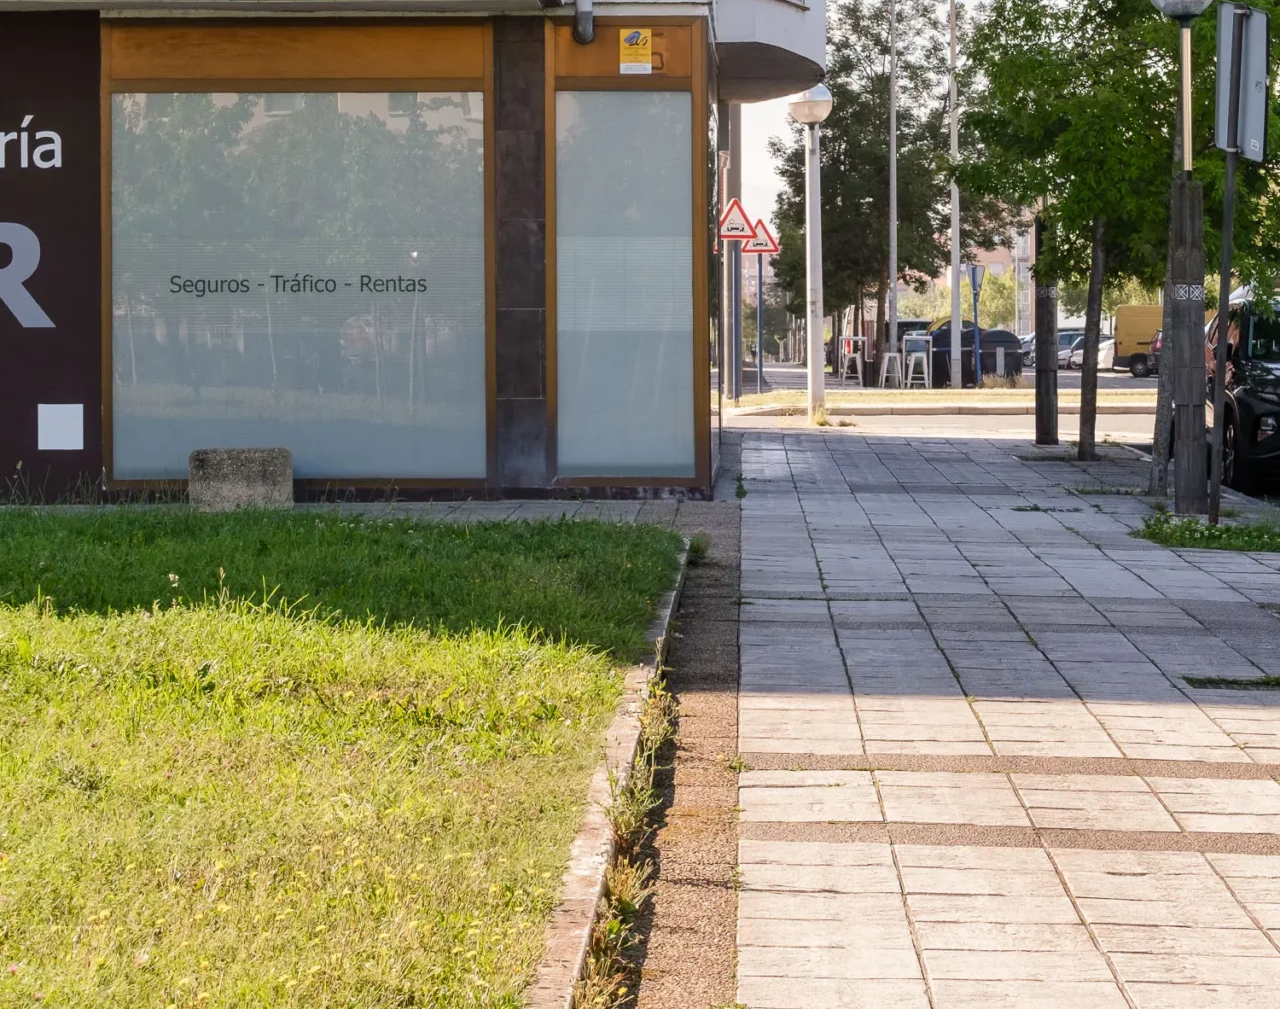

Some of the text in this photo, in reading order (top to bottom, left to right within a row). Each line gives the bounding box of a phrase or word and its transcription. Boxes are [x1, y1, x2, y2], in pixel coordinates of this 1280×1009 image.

[169, 274, 251, 298] Seguros
[270, 272, 337, 293] Tráfico
[359, 274, 428, 293] Rentas
